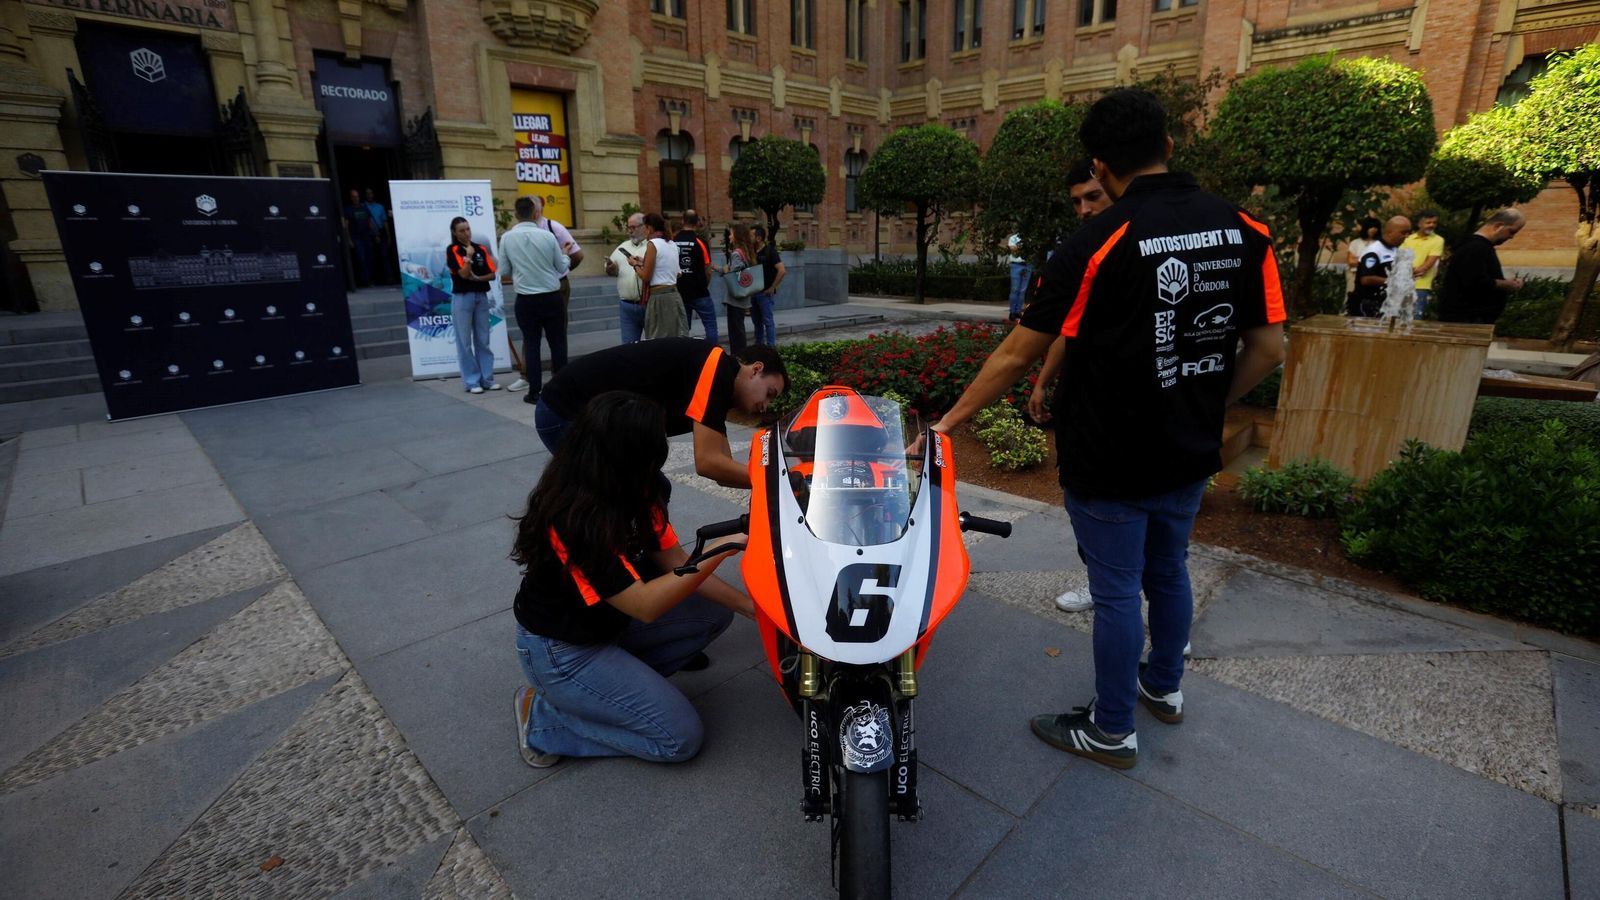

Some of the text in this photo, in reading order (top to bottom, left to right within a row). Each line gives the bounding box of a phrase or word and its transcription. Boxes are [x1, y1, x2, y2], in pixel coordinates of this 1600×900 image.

[320, 84, 388, 102] RECTORADO
[512, 114, 550, 130] LLEGAR
[518, 144, 560, 160] ESTÁ MUY
[515, 161, 561, 184] CERCA
[464, 195, 481, 206] EP
[465, 206, 484, 217] SC
[1138, 229, 1243, 257] MOTOSTUDENT VIII
[1193, 258, 1242, 273] UNIVERSIDAD
[1193, 280, 1230, 293] CÓRDOBA
[418, 314, 455, 327] INGE
[1154, 309, 1176, 328] EP
[1155, 325, 1177, 344] SC
[825, 563, 903, 643] 6
[810, 710, 821, 796] UCO ELECTRIC
[897, 709, 910, 794] UCO ELECTRIC
